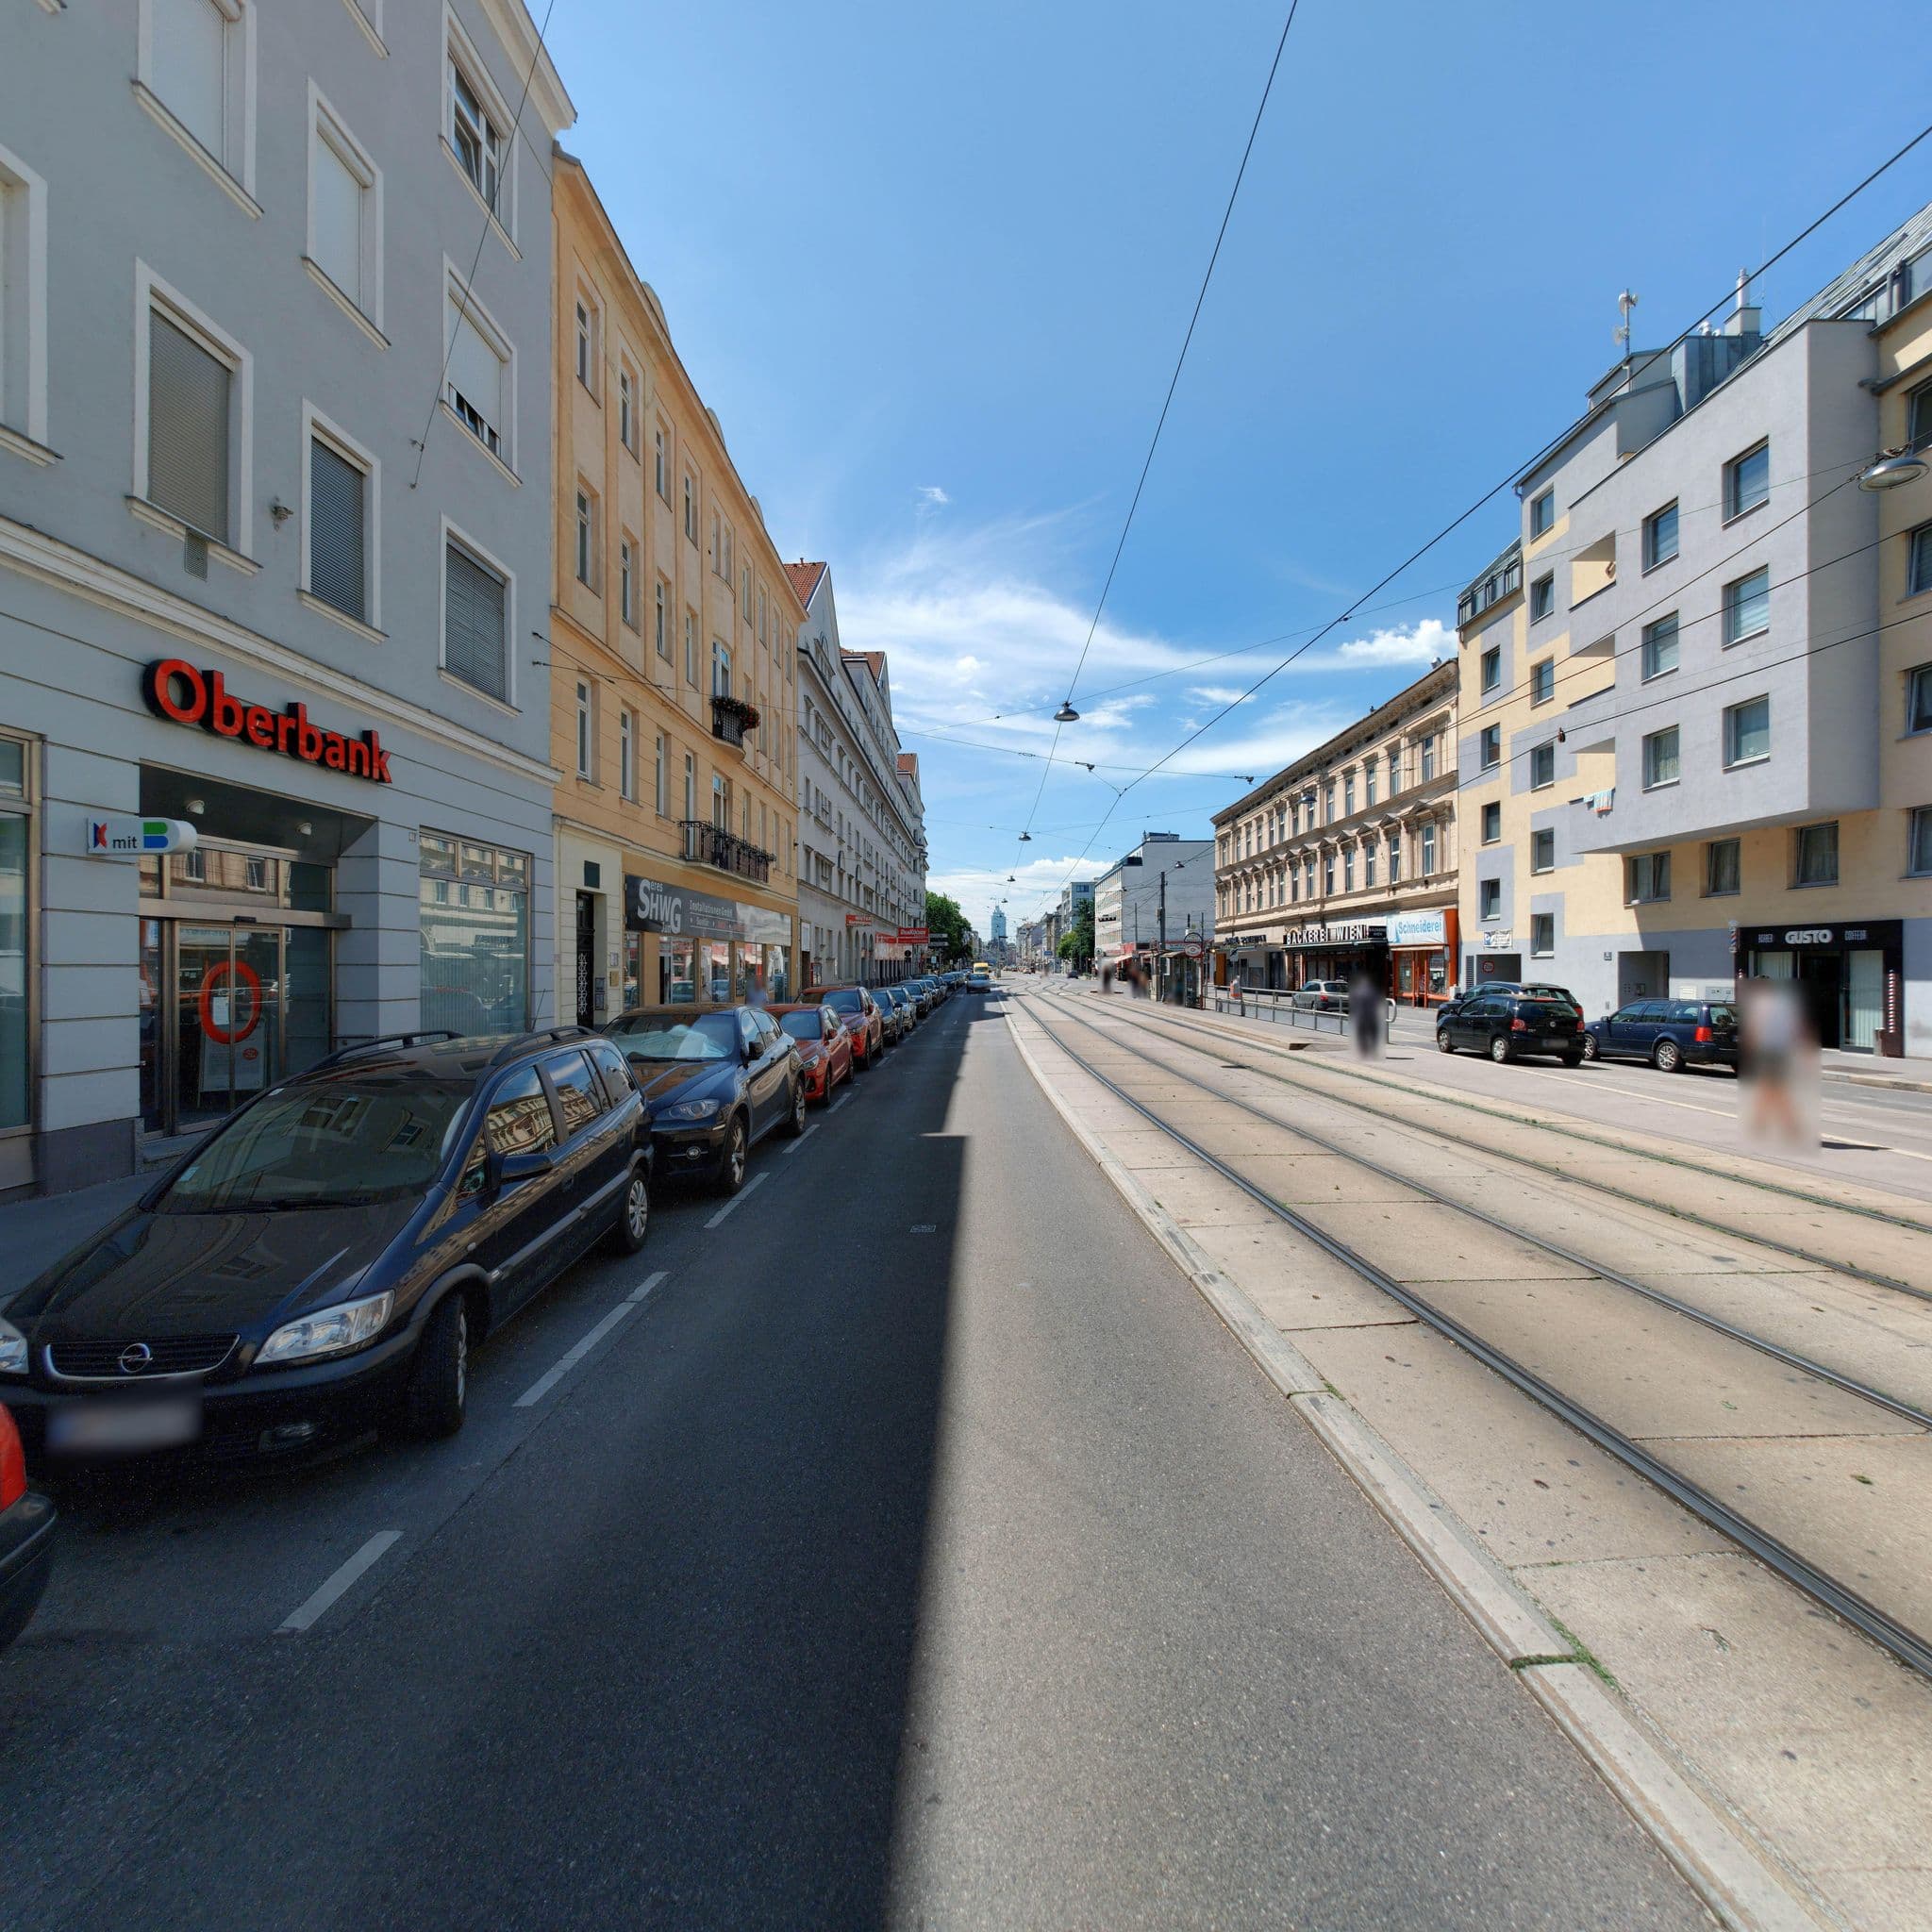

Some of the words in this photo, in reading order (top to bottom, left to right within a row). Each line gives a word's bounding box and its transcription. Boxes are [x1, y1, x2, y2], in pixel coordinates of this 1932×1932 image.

[142, 658, 392, 784] Oberbank
[112, 836, 139, 849] mit
[1336, 924, 1364, 941] WIEN
[1398, 916, 1442, 935] Schneiderei
[1784, 928, 1833, 944] GUSTO
